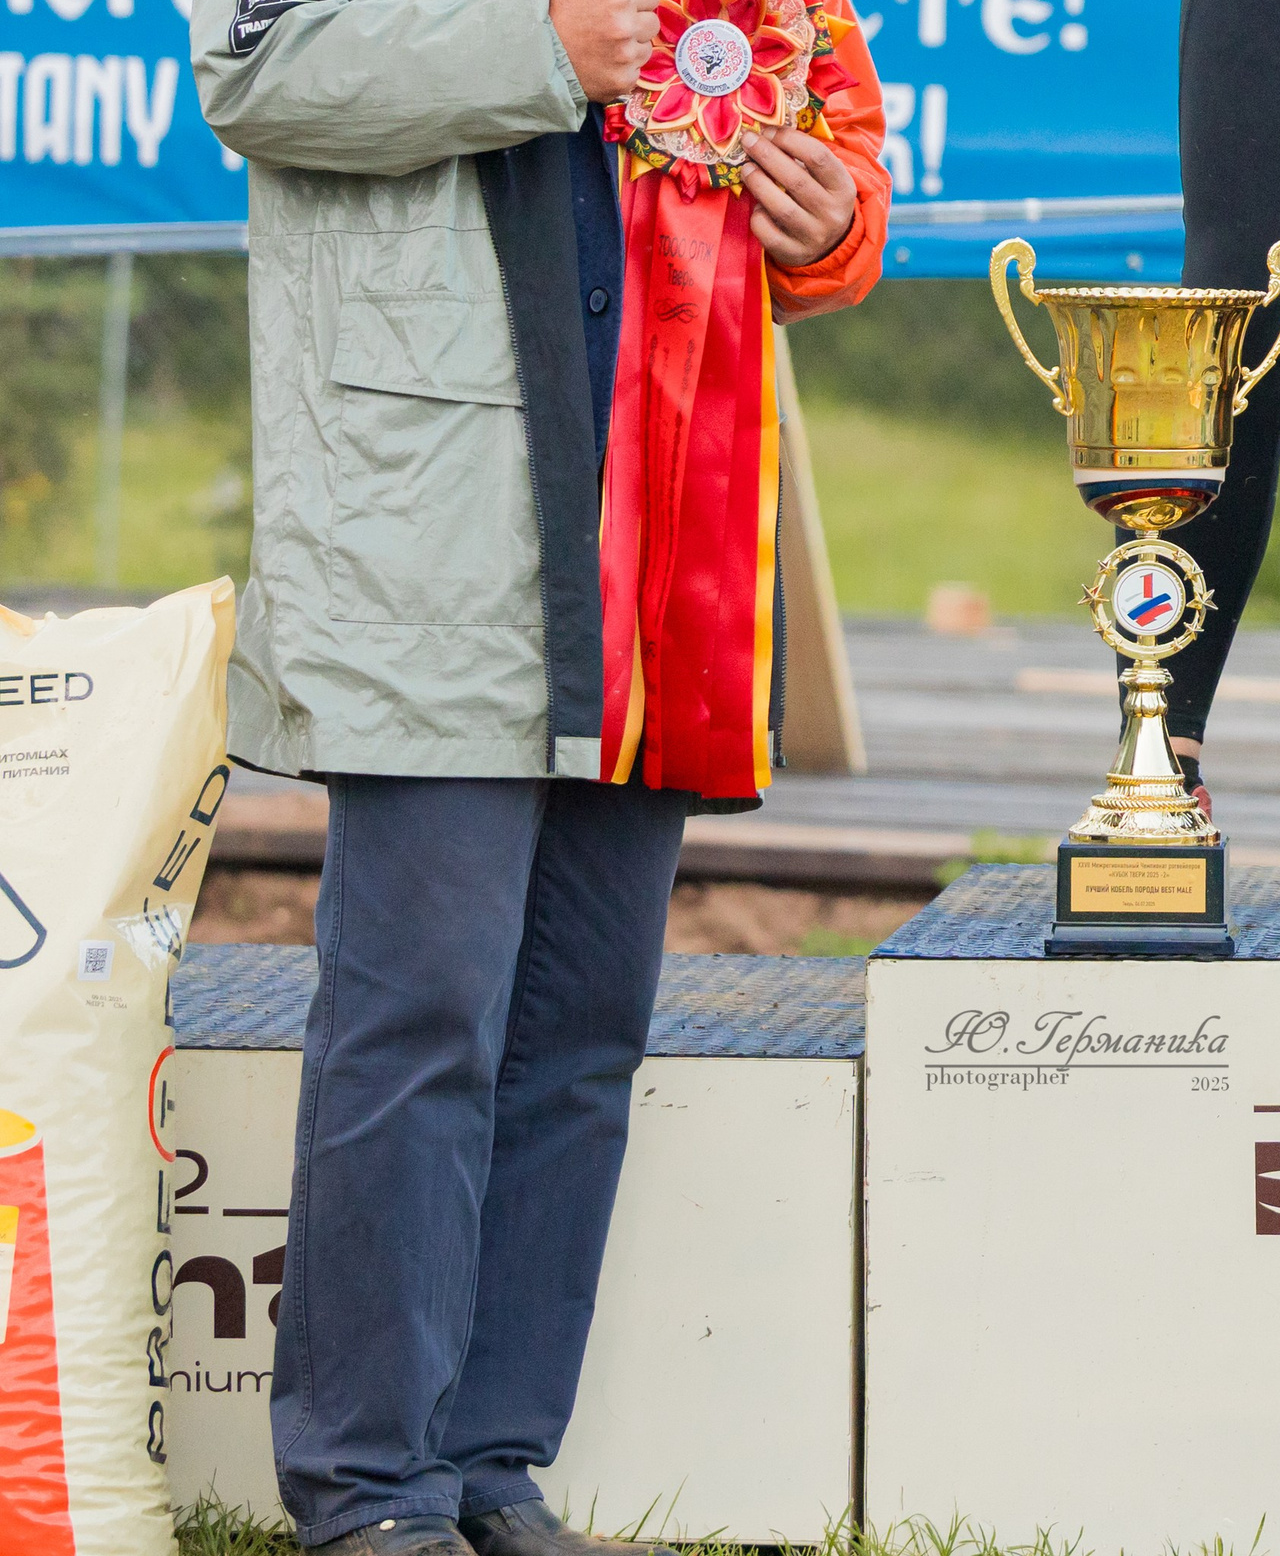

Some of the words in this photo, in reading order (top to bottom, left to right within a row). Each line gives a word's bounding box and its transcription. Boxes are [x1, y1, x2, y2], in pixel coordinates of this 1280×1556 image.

[3, 765, 70, 779] ПИТАНИЯ
[1085, 884, 1109, 893] ЛУЧШИЙ
[1110, 885, 1133, 893] КОБЕЛЬ
[1134, 885, 1160, 894] ПОРОДЫ
[1161, 886, 1175, 894] BEST
[1176, 886, 1192, 894] MALE
